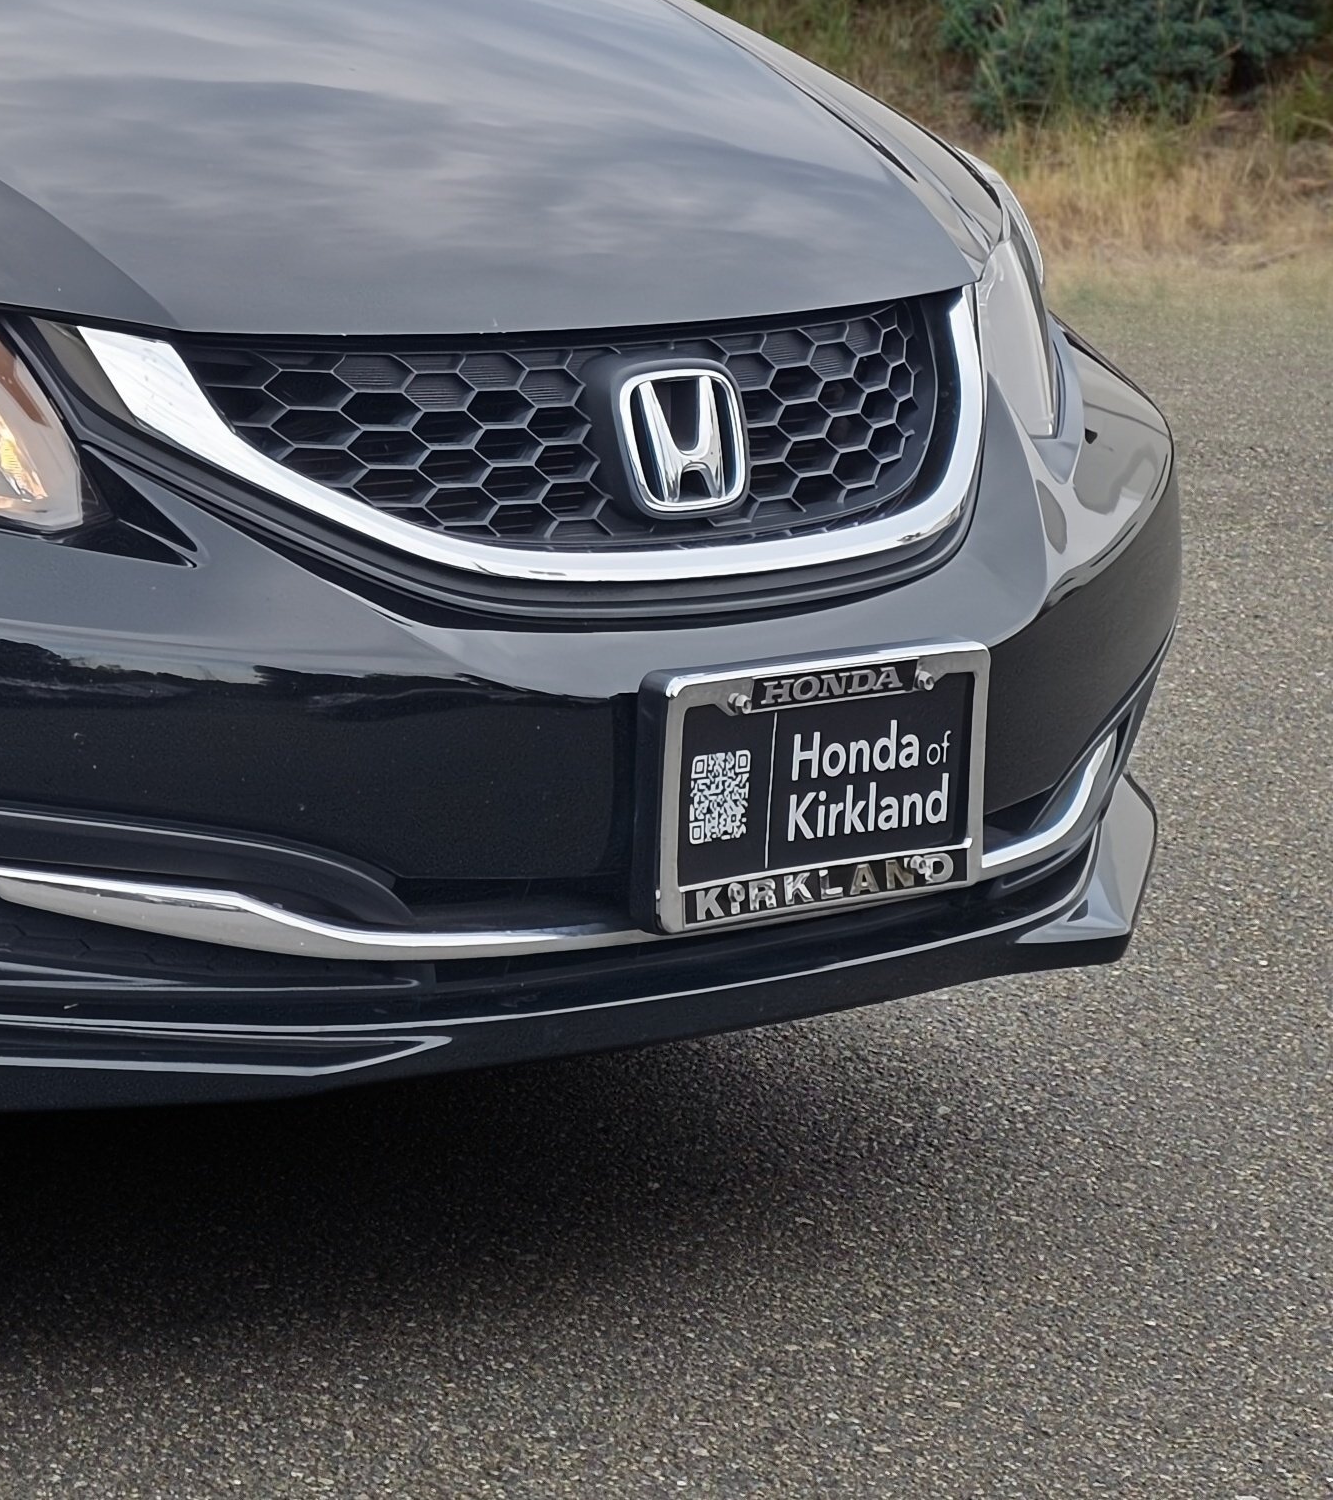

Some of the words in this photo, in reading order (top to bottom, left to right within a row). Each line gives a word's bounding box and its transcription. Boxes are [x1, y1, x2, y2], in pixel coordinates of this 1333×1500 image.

[760, 666, 903, 705] HONDA
[791, 719, 920, 781] Honda
[926, 730, 952, 765] of
[787, 772, 950, 842] Kirkland
